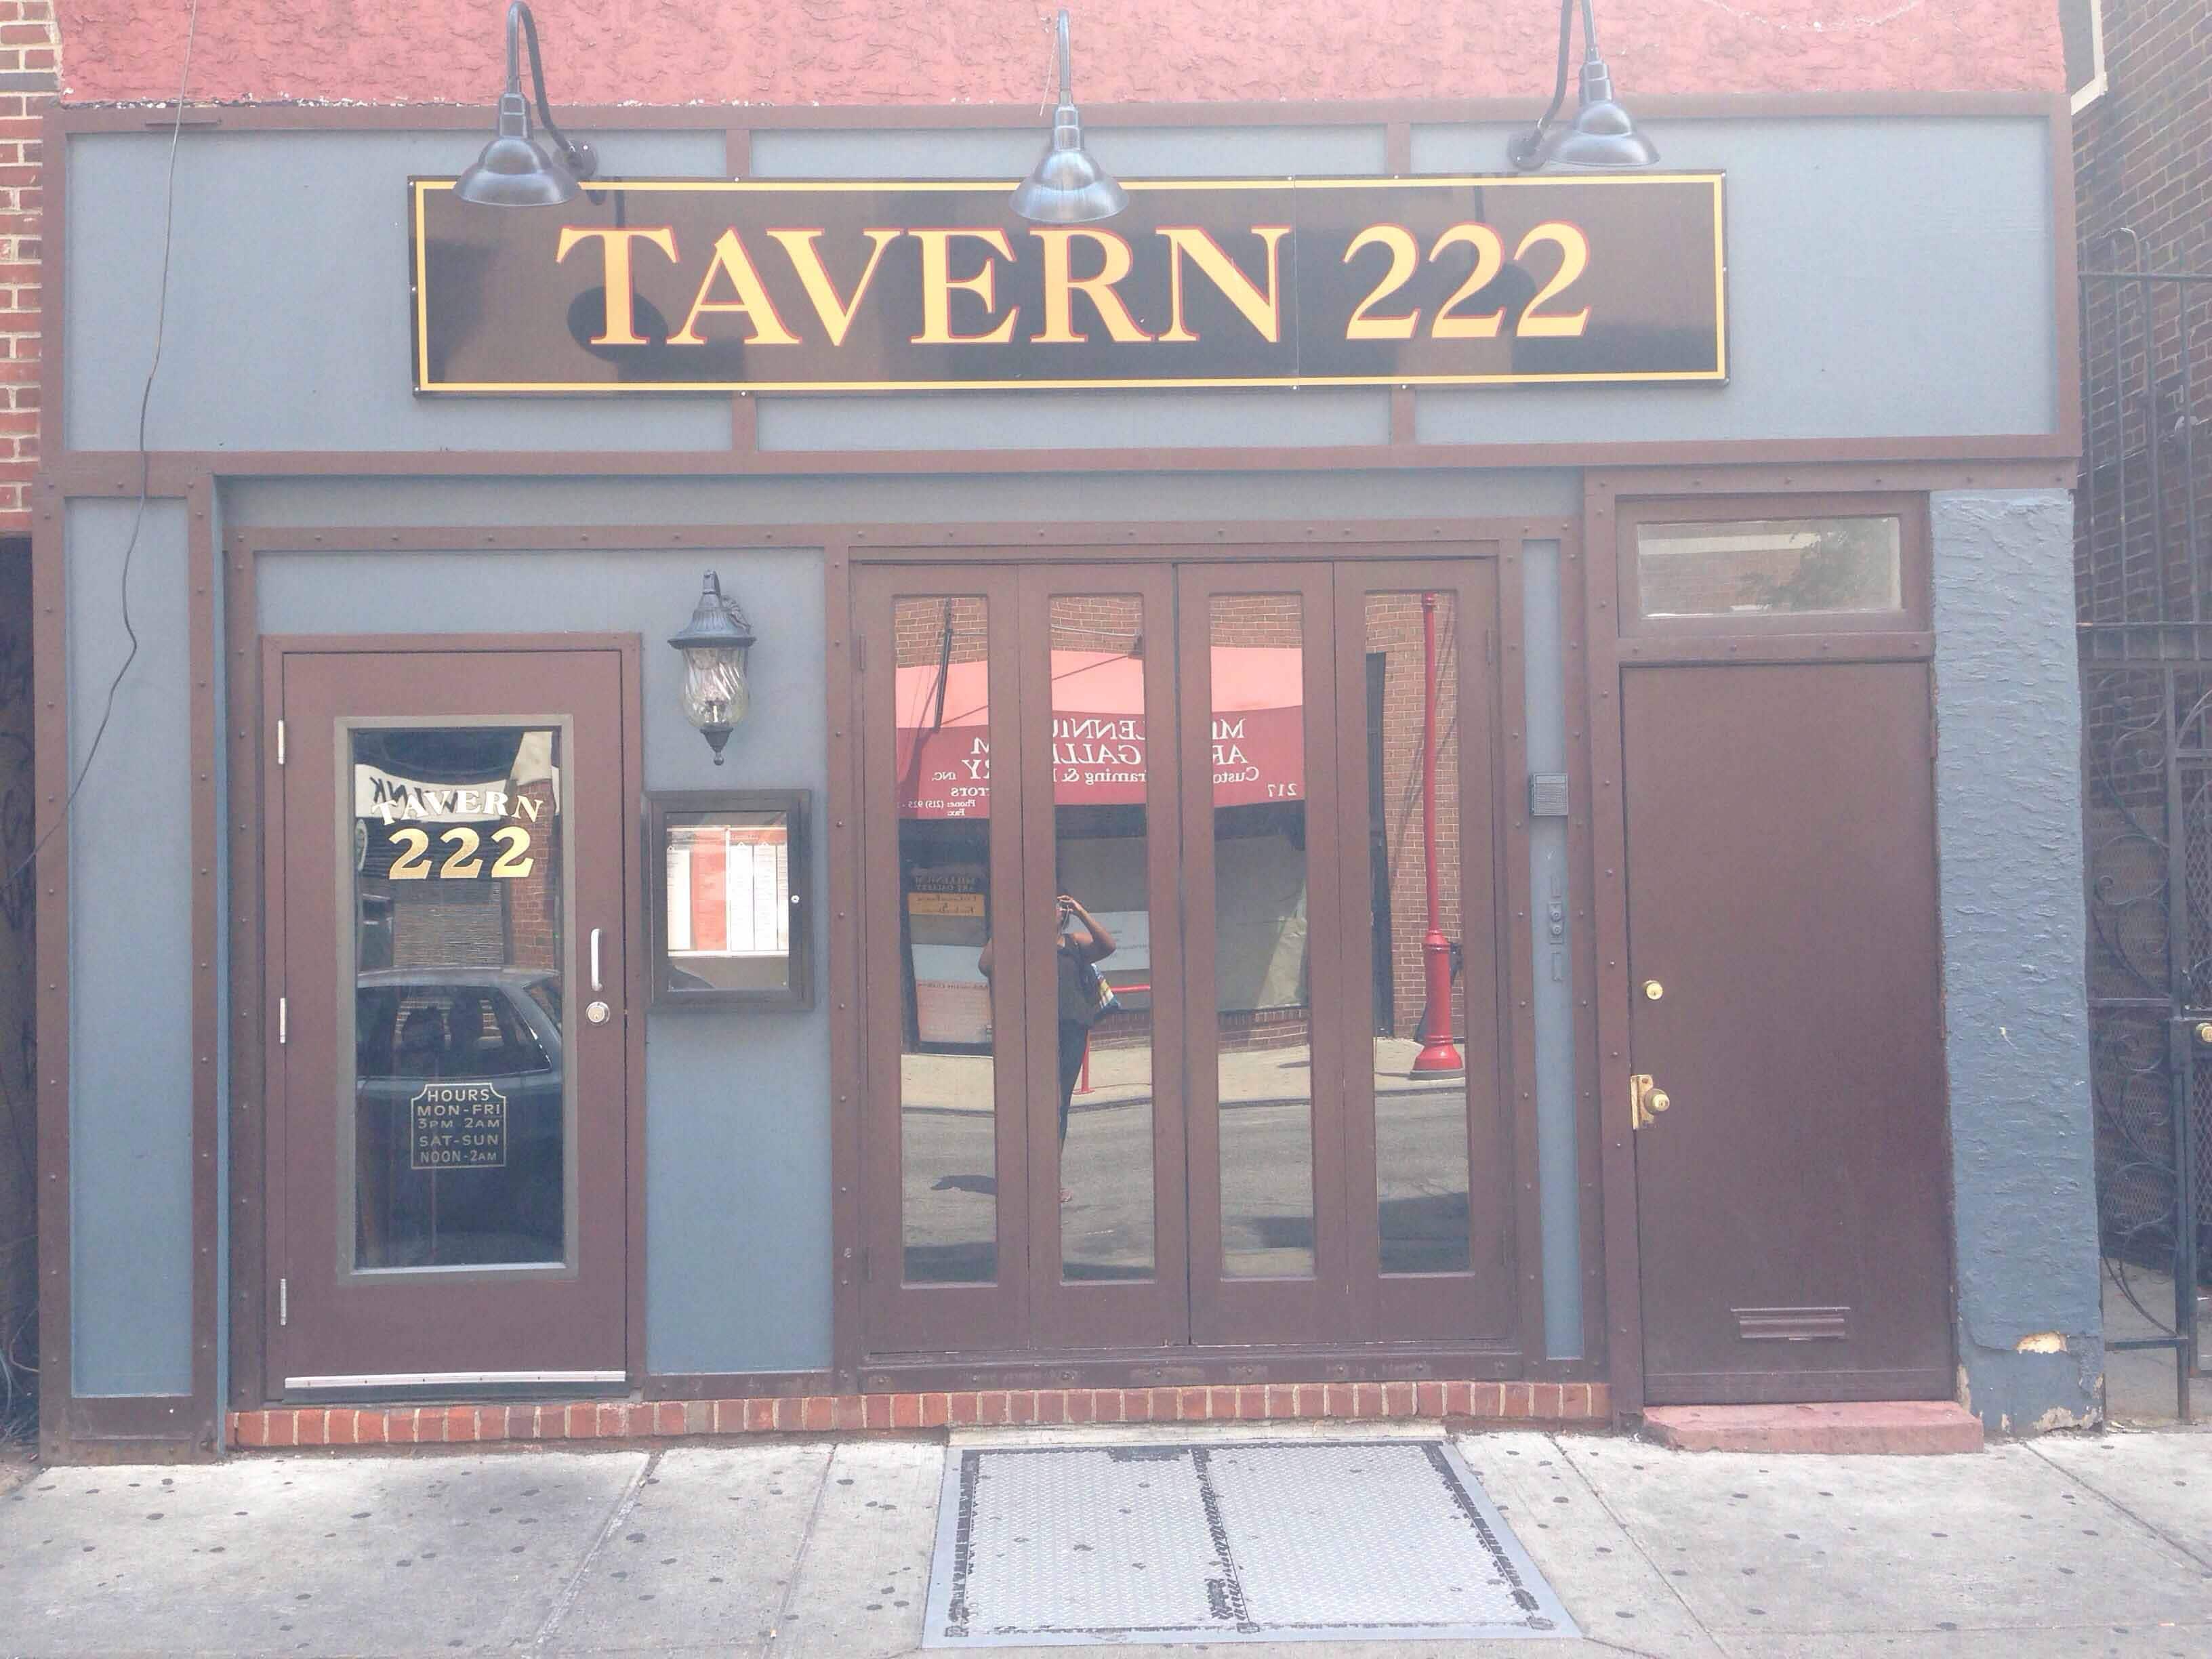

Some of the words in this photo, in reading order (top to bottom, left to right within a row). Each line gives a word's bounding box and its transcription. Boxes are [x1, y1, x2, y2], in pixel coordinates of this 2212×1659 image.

[556, 224, 1291, 347] TAVERN
[1343, 220, 1592, 340] 222
[372, 790, 544, 825] TAVERN
[388, 826, 534, 879] 222
[428, 1088, 489, 1102] HOURS
[417, 1118, 453, 1130] 3PM
[464, 1118, 499, 1129] 2AM
[419, 1134, 499, 1147] SAT-SUN
